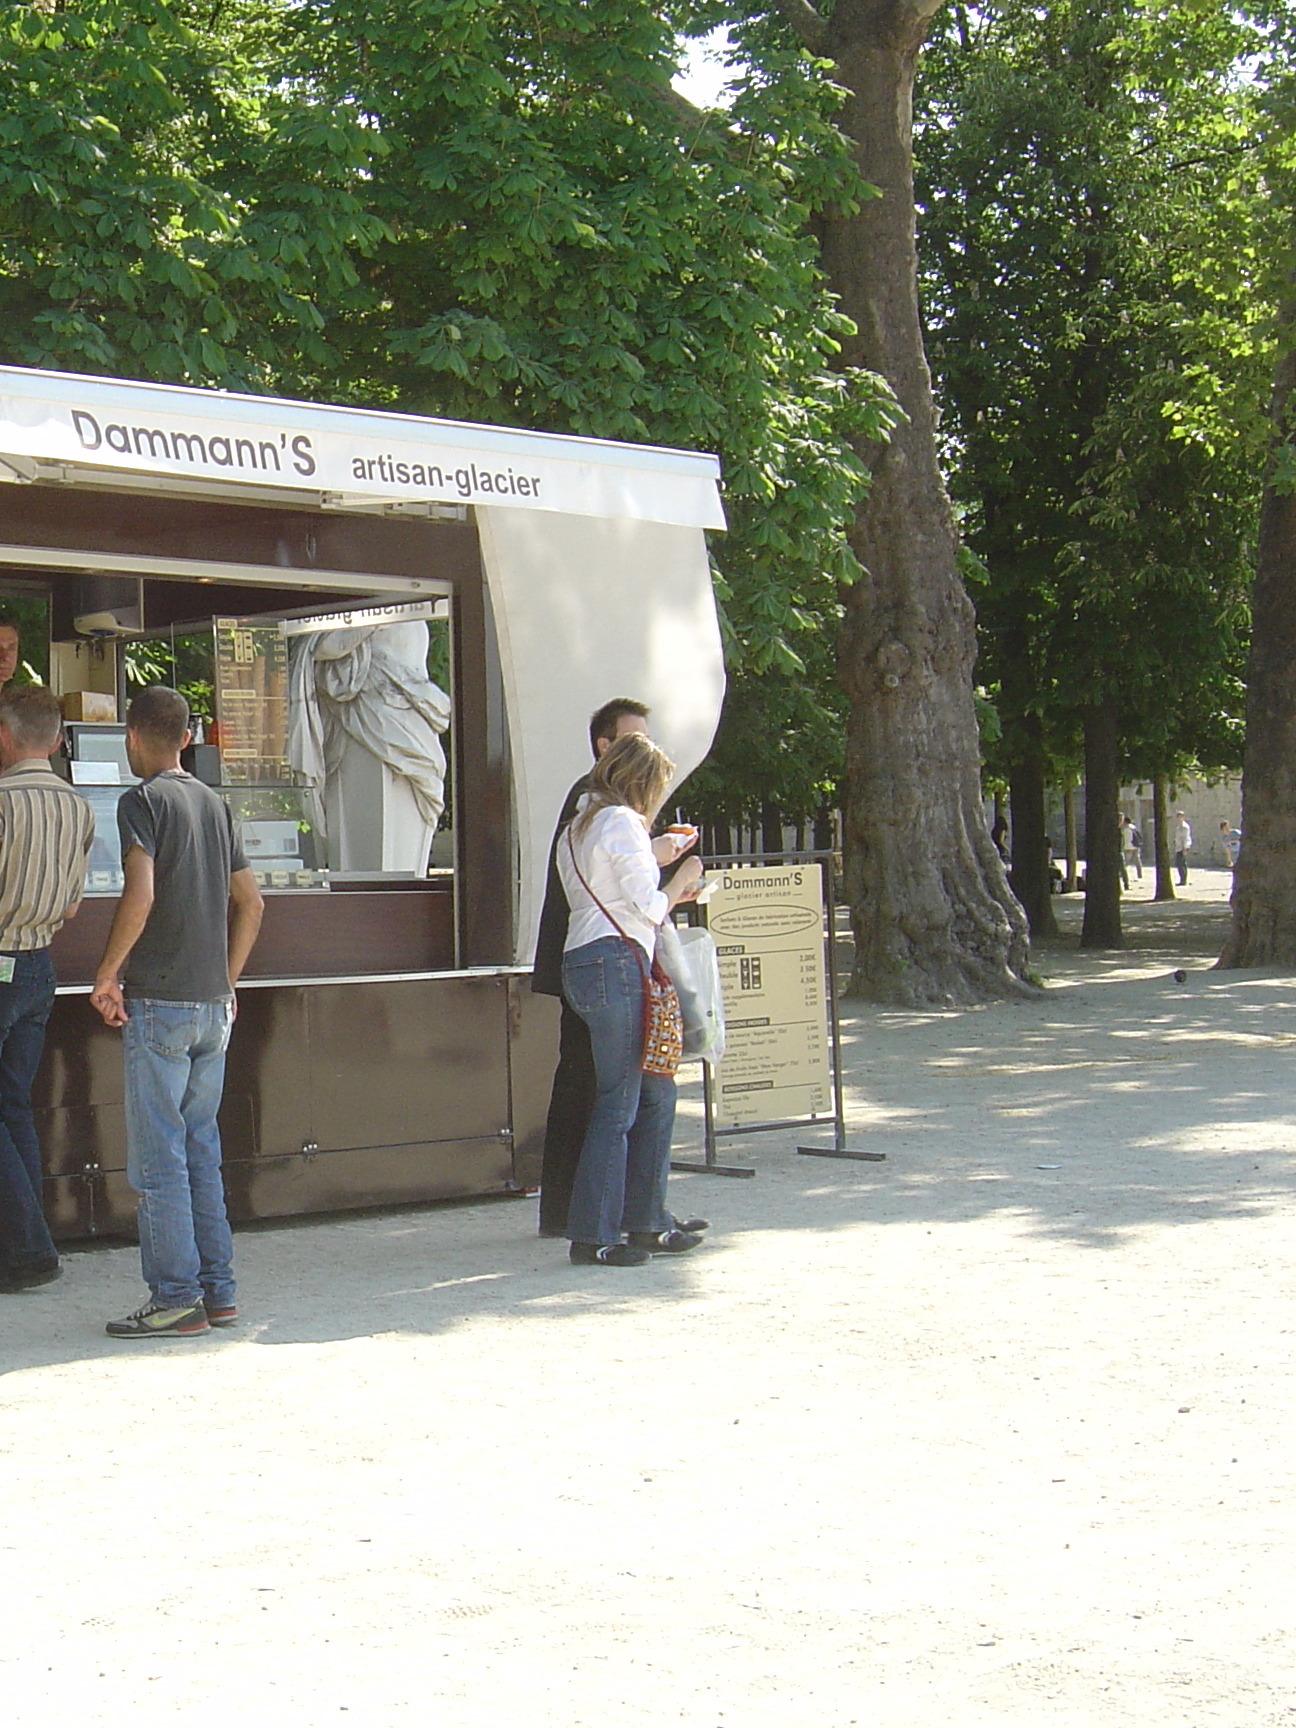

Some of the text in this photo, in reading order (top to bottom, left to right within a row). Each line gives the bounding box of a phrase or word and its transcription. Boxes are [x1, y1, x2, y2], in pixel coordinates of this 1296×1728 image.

[71, 409, 542, 498] Dammann'S artisan-glacier
[723, 872, 803, 890] Dammann'S
[736, 890, 791, 901] glacier artisan
